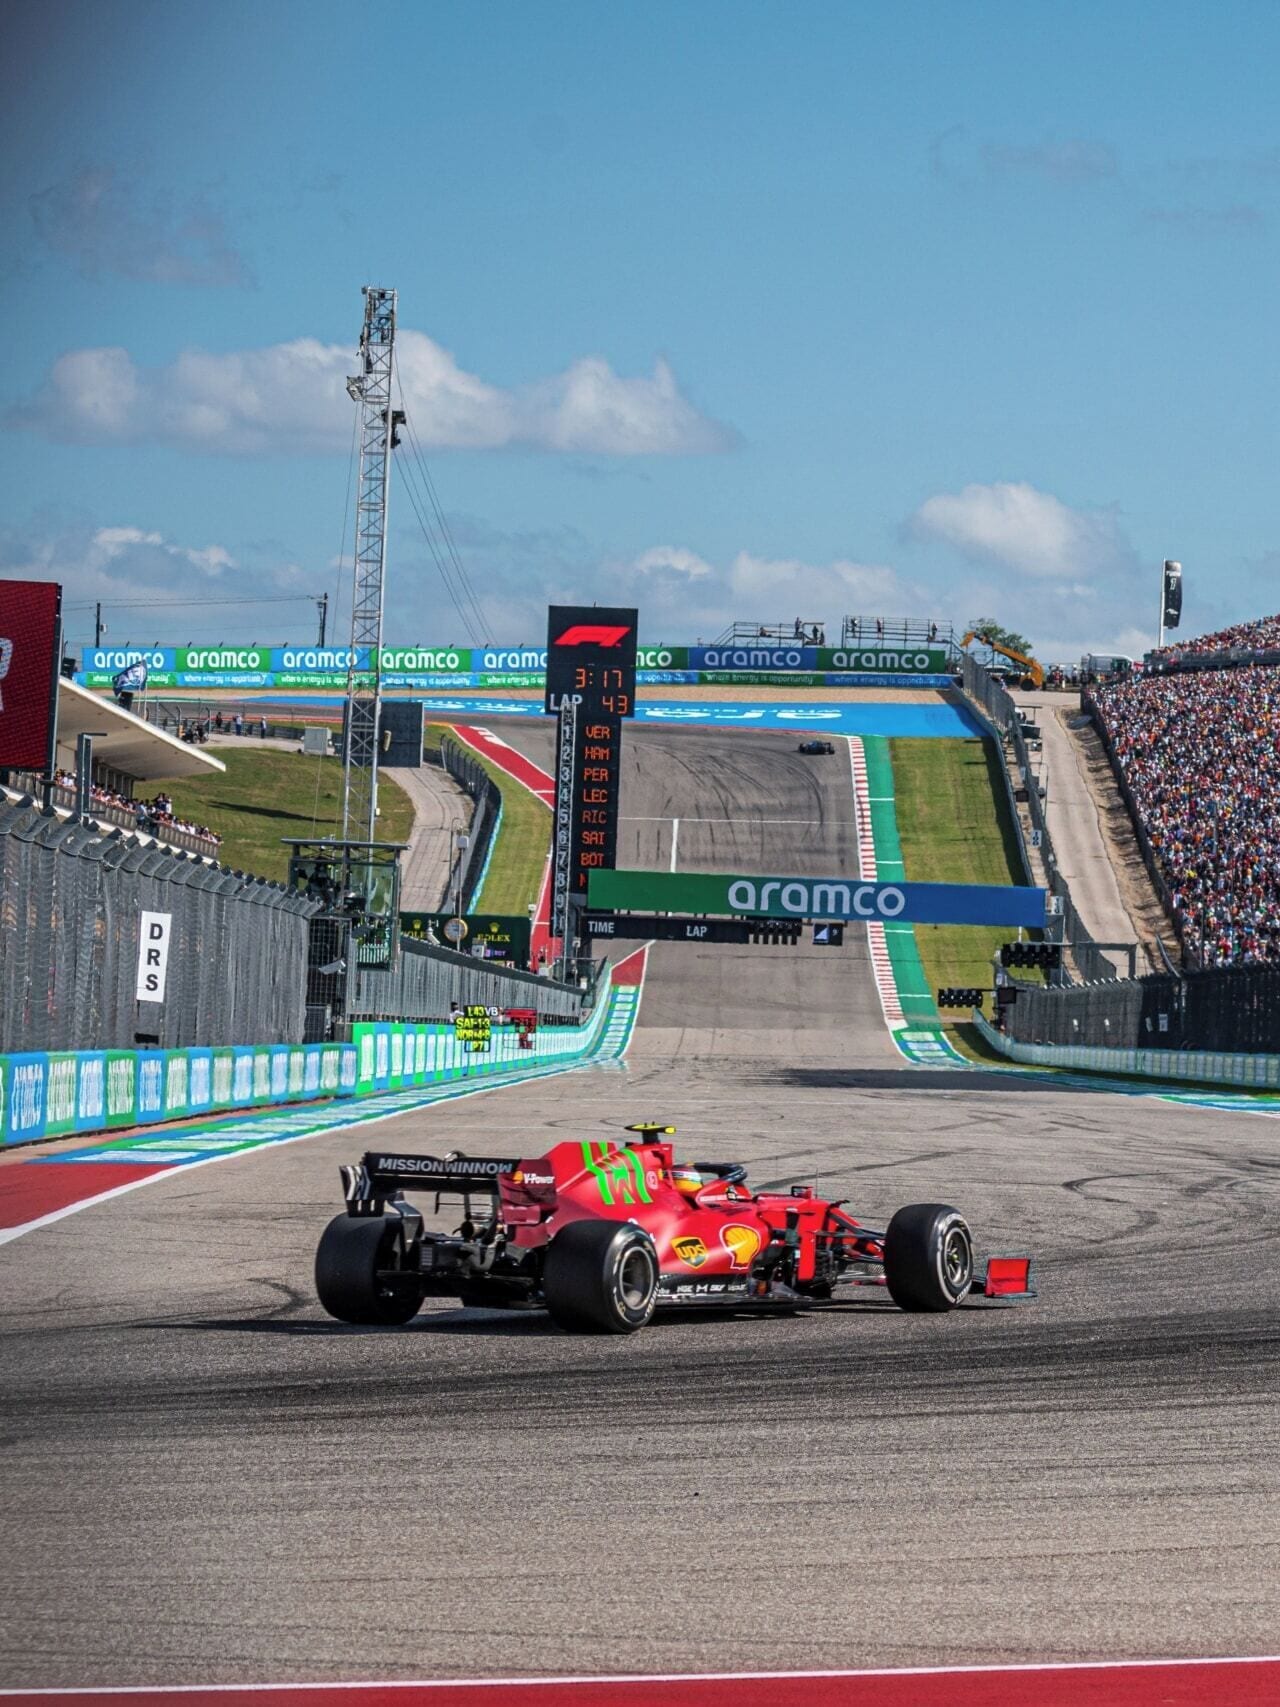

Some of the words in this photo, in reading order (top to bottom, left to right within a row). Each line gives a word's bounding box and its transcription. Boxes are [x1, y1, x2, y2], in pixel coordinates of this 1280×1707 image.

[186, 651, 260, 668] aramco
[283, 651, 358, 668] aramco
[382, 651, 460, 669] aramco
[484, 651, 547, 669] aramc
[704, 650, 801, 667] aramco
[832, 651, 930, 669] aramco
[575, 668, 622, 688] 3:17
[769, 675, 813, 685] opportunity
[602, 695, 628, 714] 43
[563, 725, 570, 739] 1
[586, 725, 610, 739] VER
[562, 745, 570, 760] 2
[585, 746, 609, 760] HAM
[561, 766, 570, 781] 3
[584, 768, 608, 781] PER
[560, 788, 569, 802] 4
[583, 789, 608, 802] LEC
[560, 809, 569, 824] 5
[582, 810, 607, 824] RIC
[559, 830, 566, 845] 6
[581, 831, 605, 845] SAI
[557, 852, 566, 866] 7
[581, 853, 604, 866] BOT
[728, 880, 906, 917] aramco
[588, 921, 615, 933] TIME
[686, 925, 708, 937] LAP
[145, 923, 163, 991] DRS
[523, 1172, 555, 1185] V-Power
